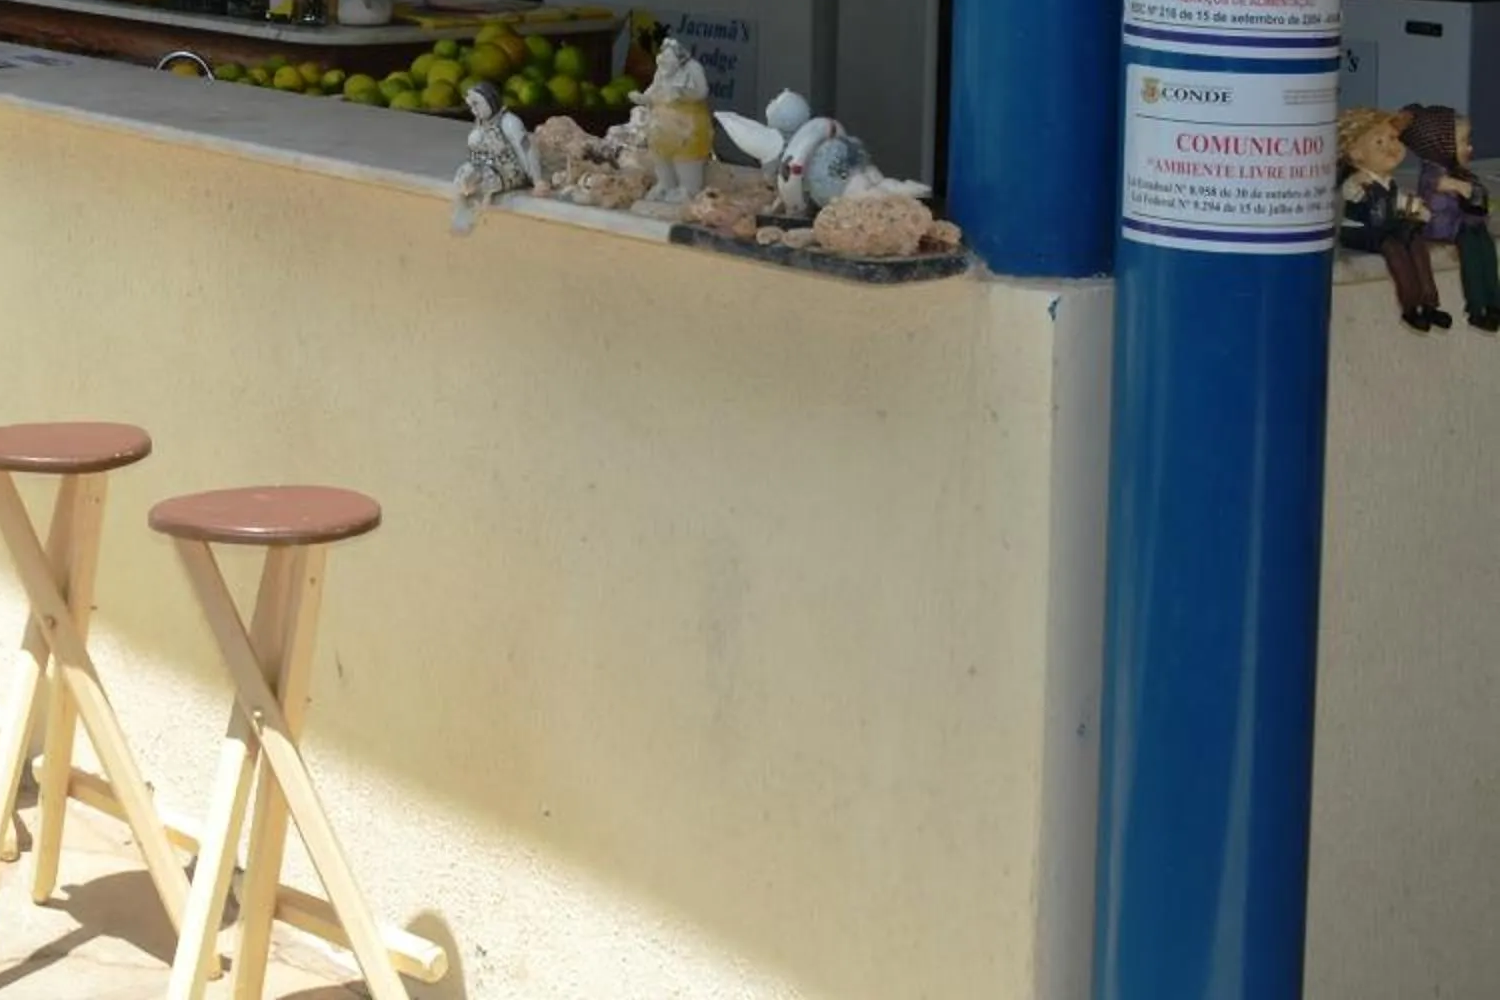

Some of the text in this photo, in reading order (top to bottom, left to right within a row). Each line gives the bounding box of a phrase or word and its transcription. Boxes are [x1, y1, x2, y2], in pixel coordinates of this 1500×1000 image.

[1179, 8, 1193, 20] de
[1213, 11, 1227, 22] de
[1230, 12, 1285, 25] setembro
[690, 44, 738, 73] Lodge
[707, 78, 736, 101] otel
[1161, 87, 1234, 103] CONDE
[1177, 132, 1324, 156] COMUNICADO
[1239, 164, 1285, 179] LIVRE
